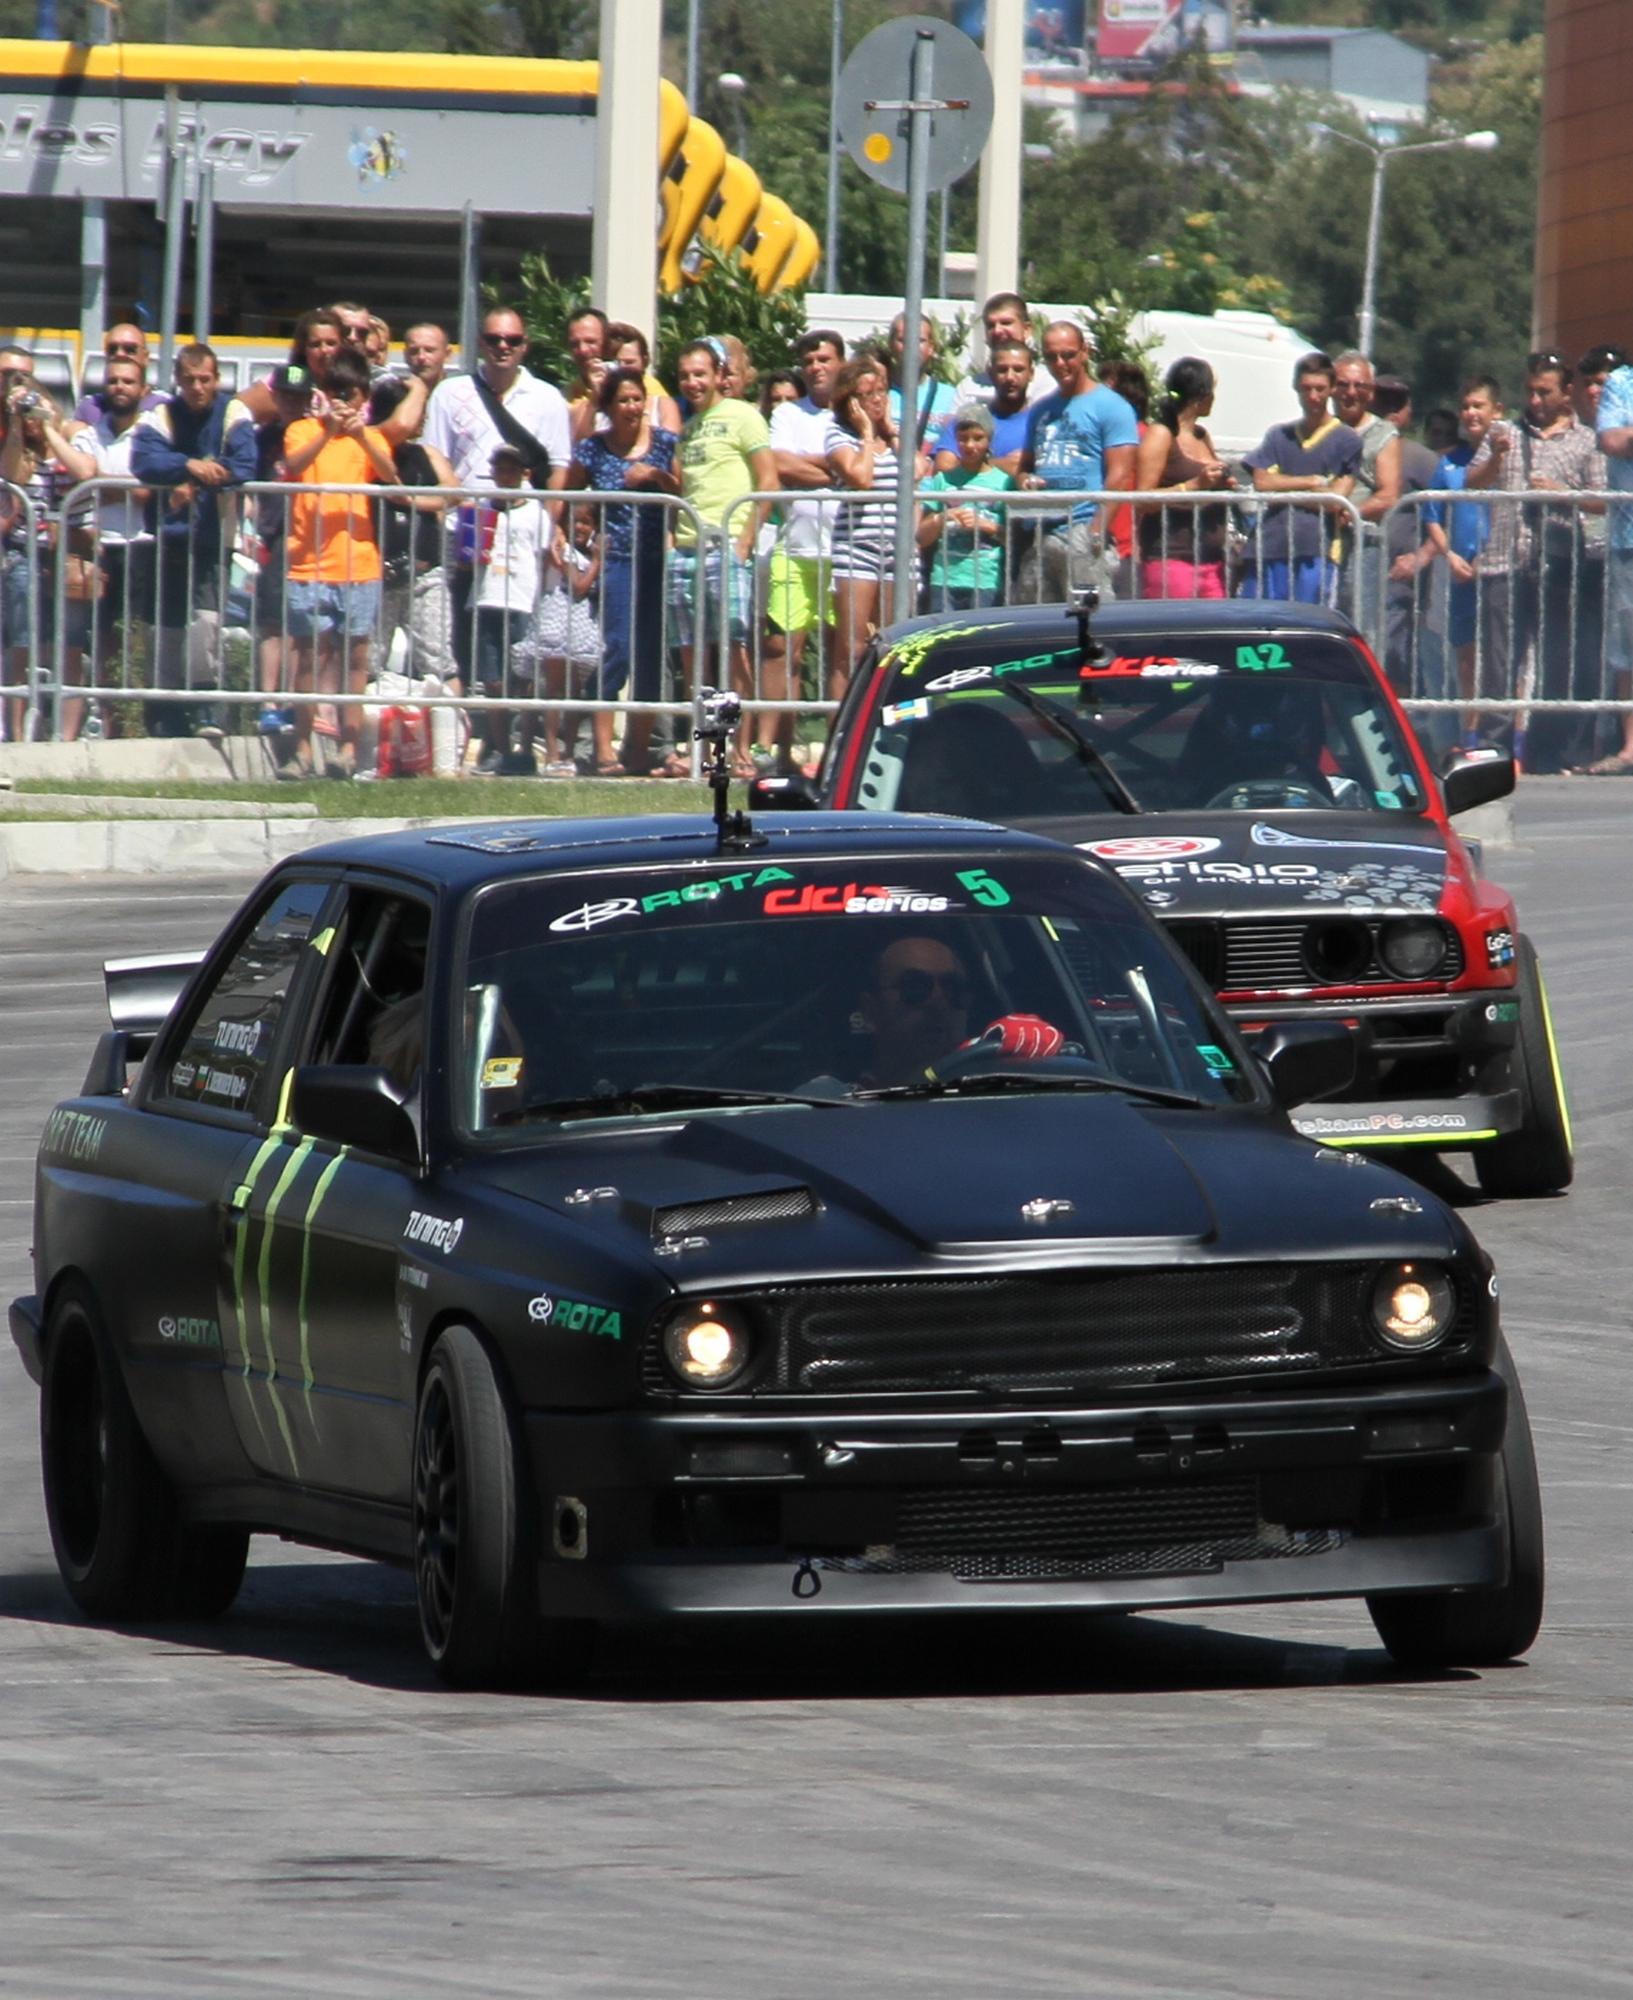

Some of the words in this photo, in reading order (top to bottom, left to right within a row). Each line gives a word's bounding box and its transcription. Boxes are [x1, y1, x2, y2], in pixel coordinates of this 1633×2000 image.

[0, 103, 120, 165] les
[1140, 663, 1219, 677] series
[1236, 643, 1291, 671] 42
[641, 867, 795, 913] ROTA
[845, 896, 948, 914] series
[955, 869, 1011, 907] 5
[403, 1210, 450, 1248] TUNING
[177, 1317, 221, 1345] ROTA
[551, 1299, 622, 1340] ROTA
